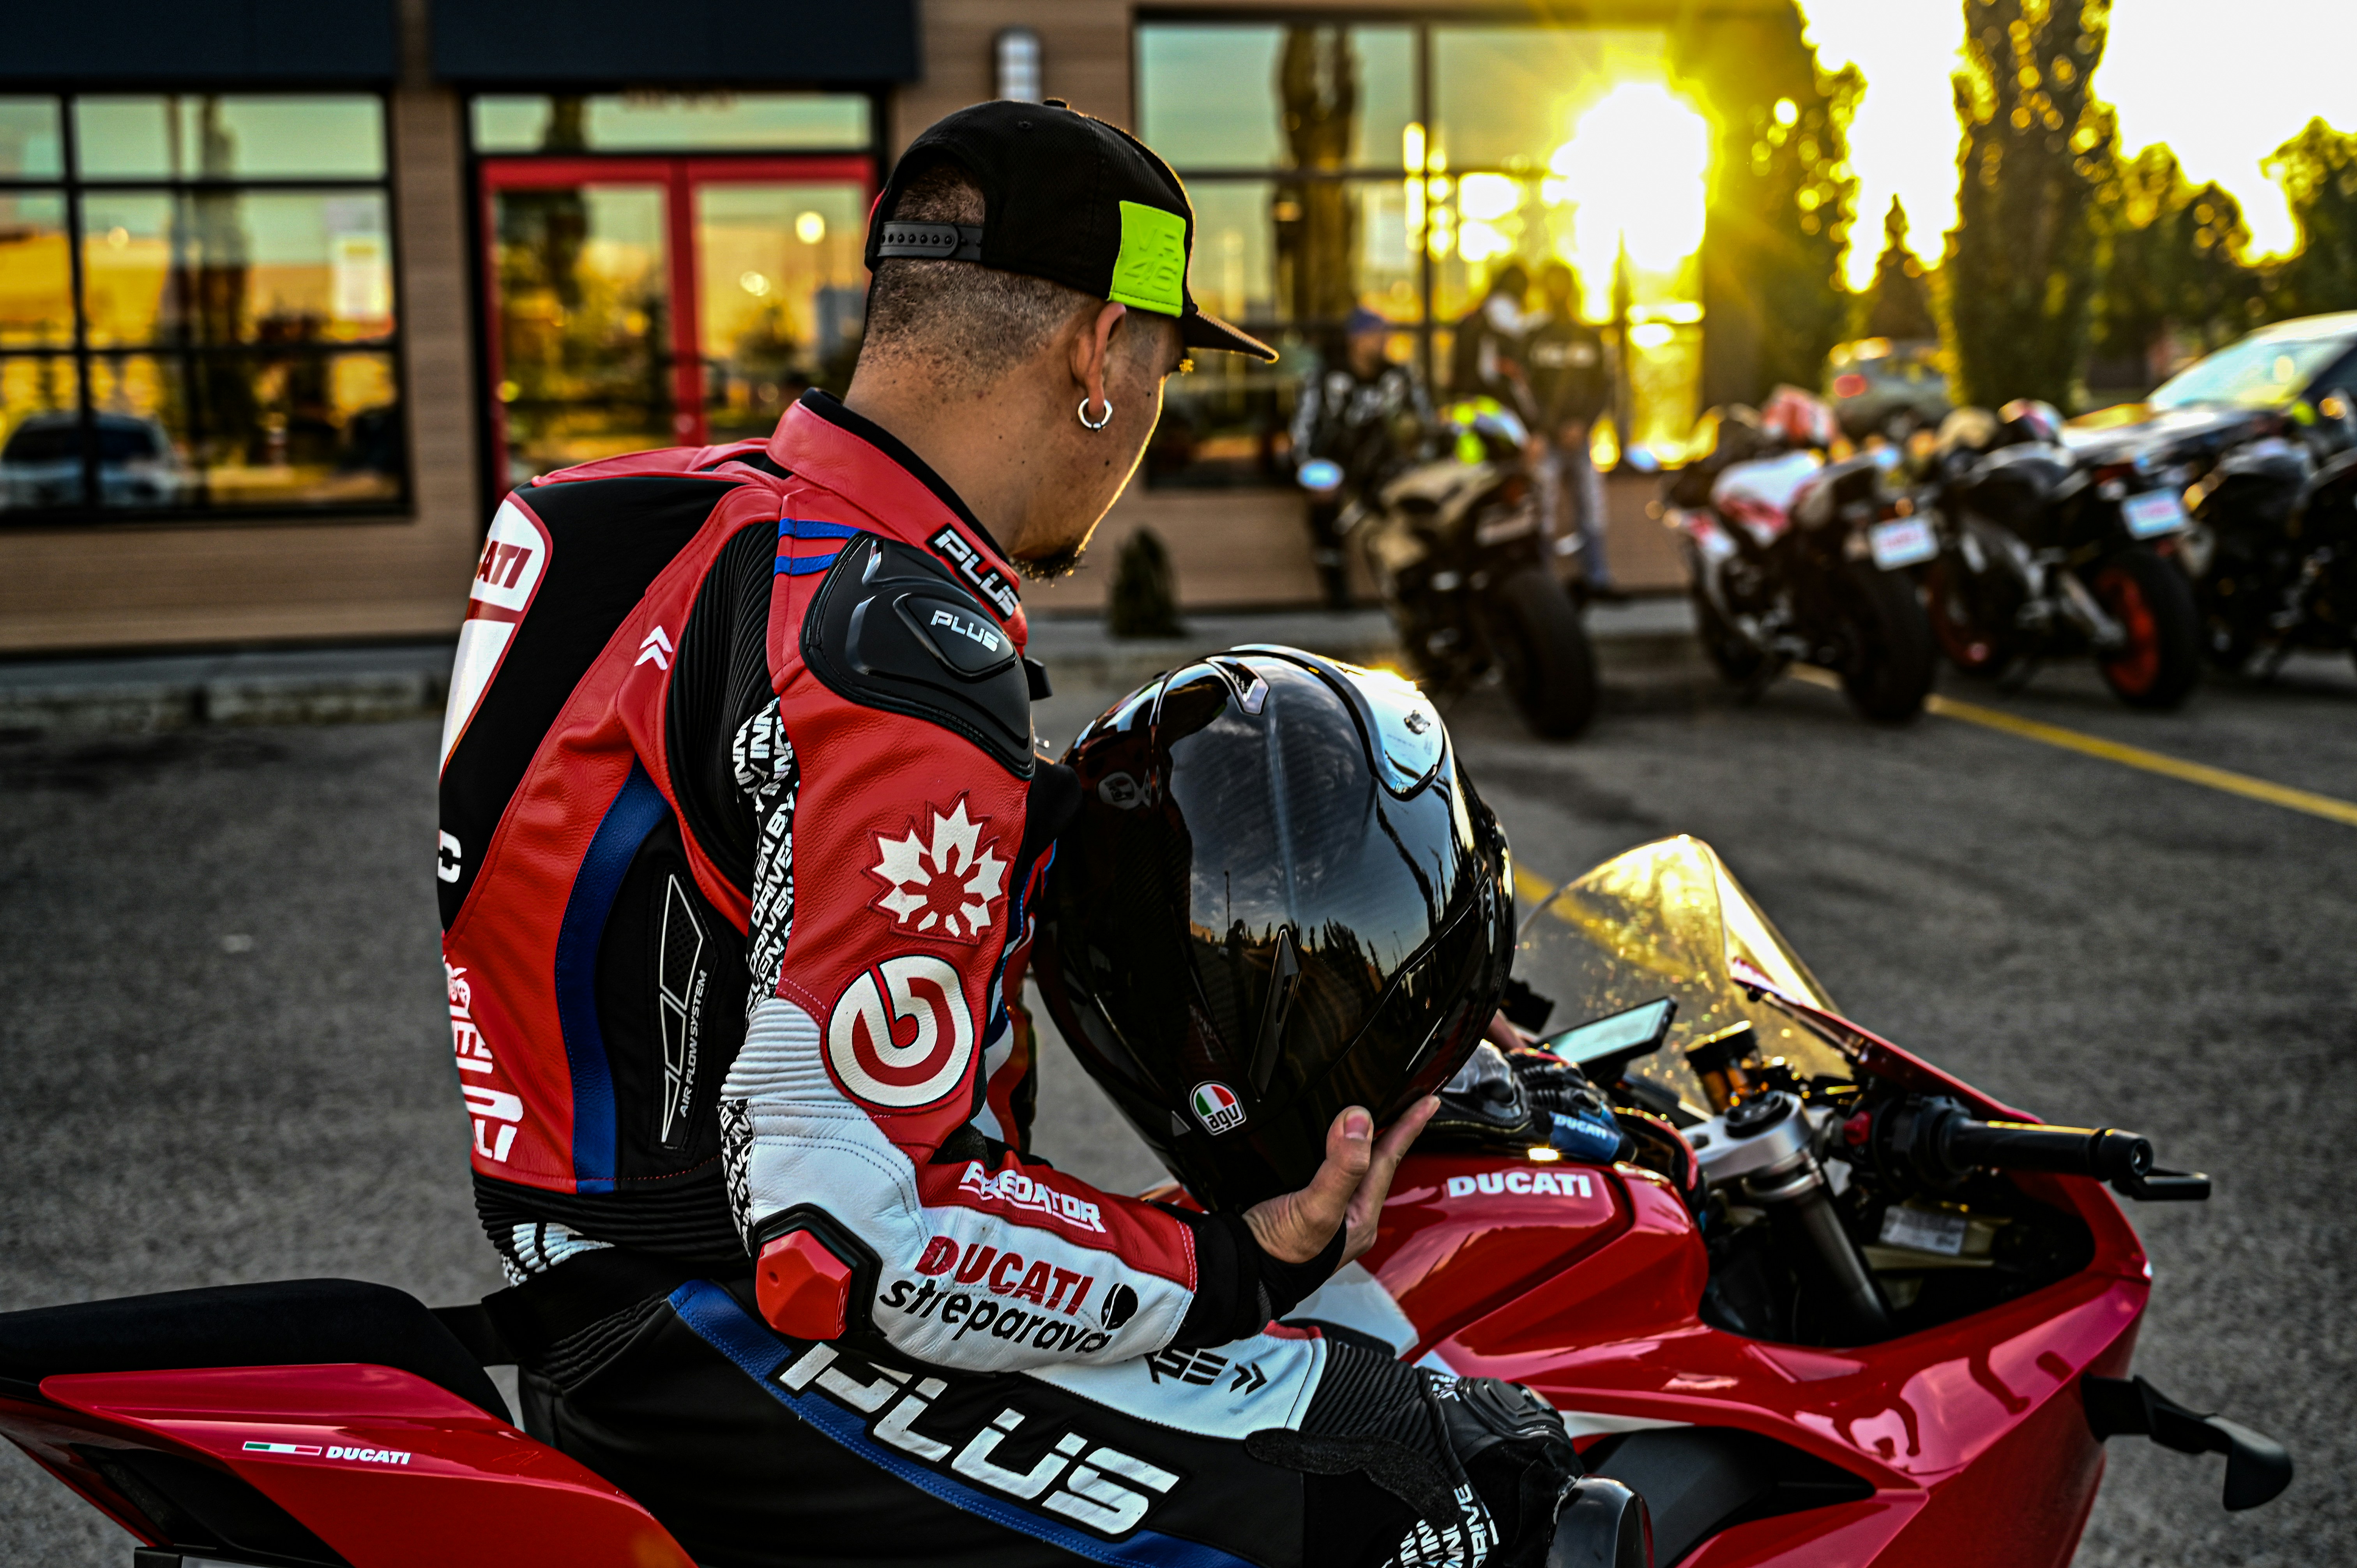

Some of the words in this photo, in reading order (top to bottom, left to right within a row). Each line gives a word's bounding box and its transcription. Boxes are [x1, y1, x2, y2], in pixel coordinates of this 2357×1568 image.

[476, 537, 533, 589] ATI
[935, 529, 1016, 618] PLUS
[931, 609, 999, 652] PLUS
[690, 969, 707, 1037] SYSTEM
[686, 1037, 698, 1085] FLOW
[680, 1086, 692, 1118] AIR
[1207, 1104, 1239, 1129] agv
[1553, 1114, 1607, 1139] DUCATI
[959, 1161, 1107, 1233] PREDATOR
[1446, 1171, 1592, 1198] DUCATI
[914, 1236, 1094, 1316] DUCATI
[879, 1279, 1111, 1353] streparava
[326, 1446, 411, 1465] DUCATI
[779, 1342, 1180, 1535] PLUS
